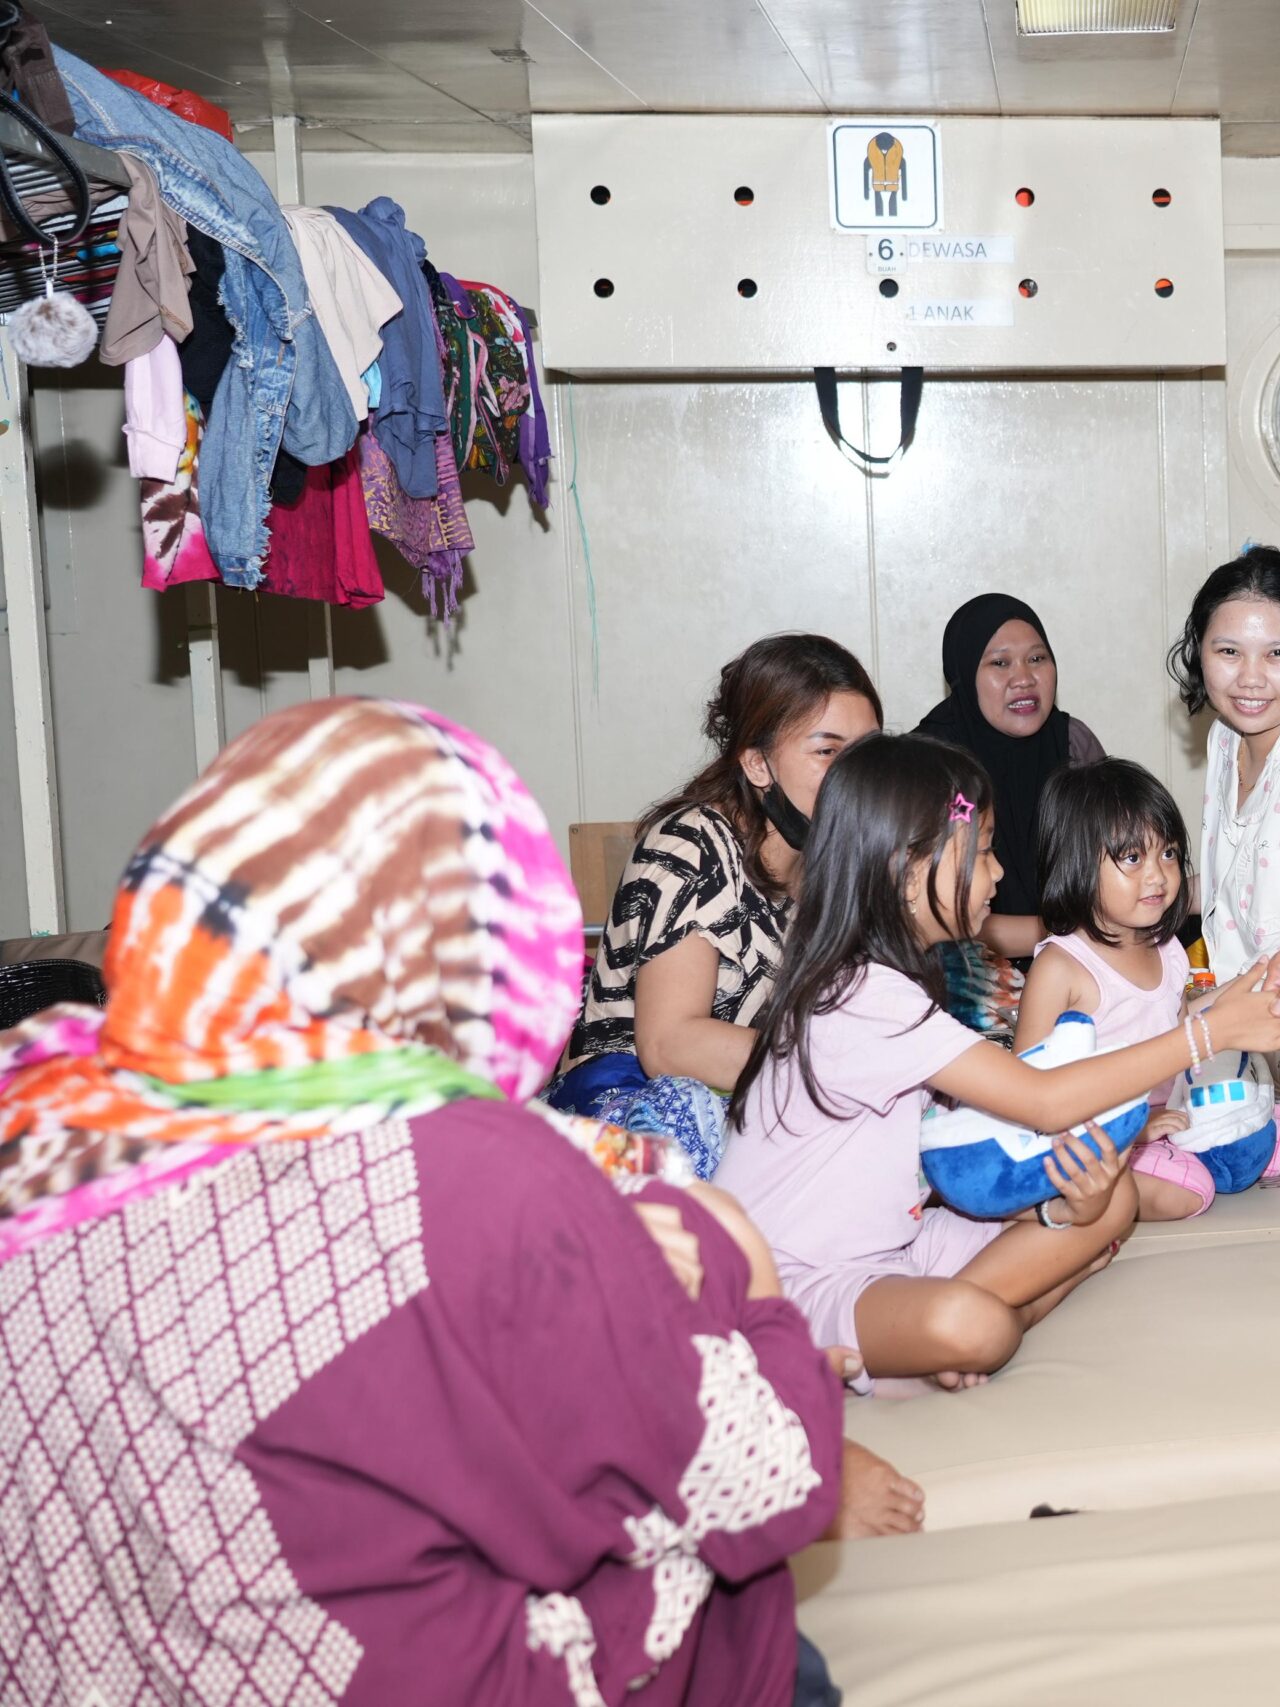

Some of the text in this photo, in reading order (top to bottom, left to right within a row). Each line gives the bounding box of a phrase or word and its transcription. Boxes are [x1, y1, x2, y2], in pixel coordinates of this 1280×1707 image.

[878, 239, 894, 260] 6
[909, 243, 987, 258] DEWASA
[924, 305, 974, 321] ANAK
